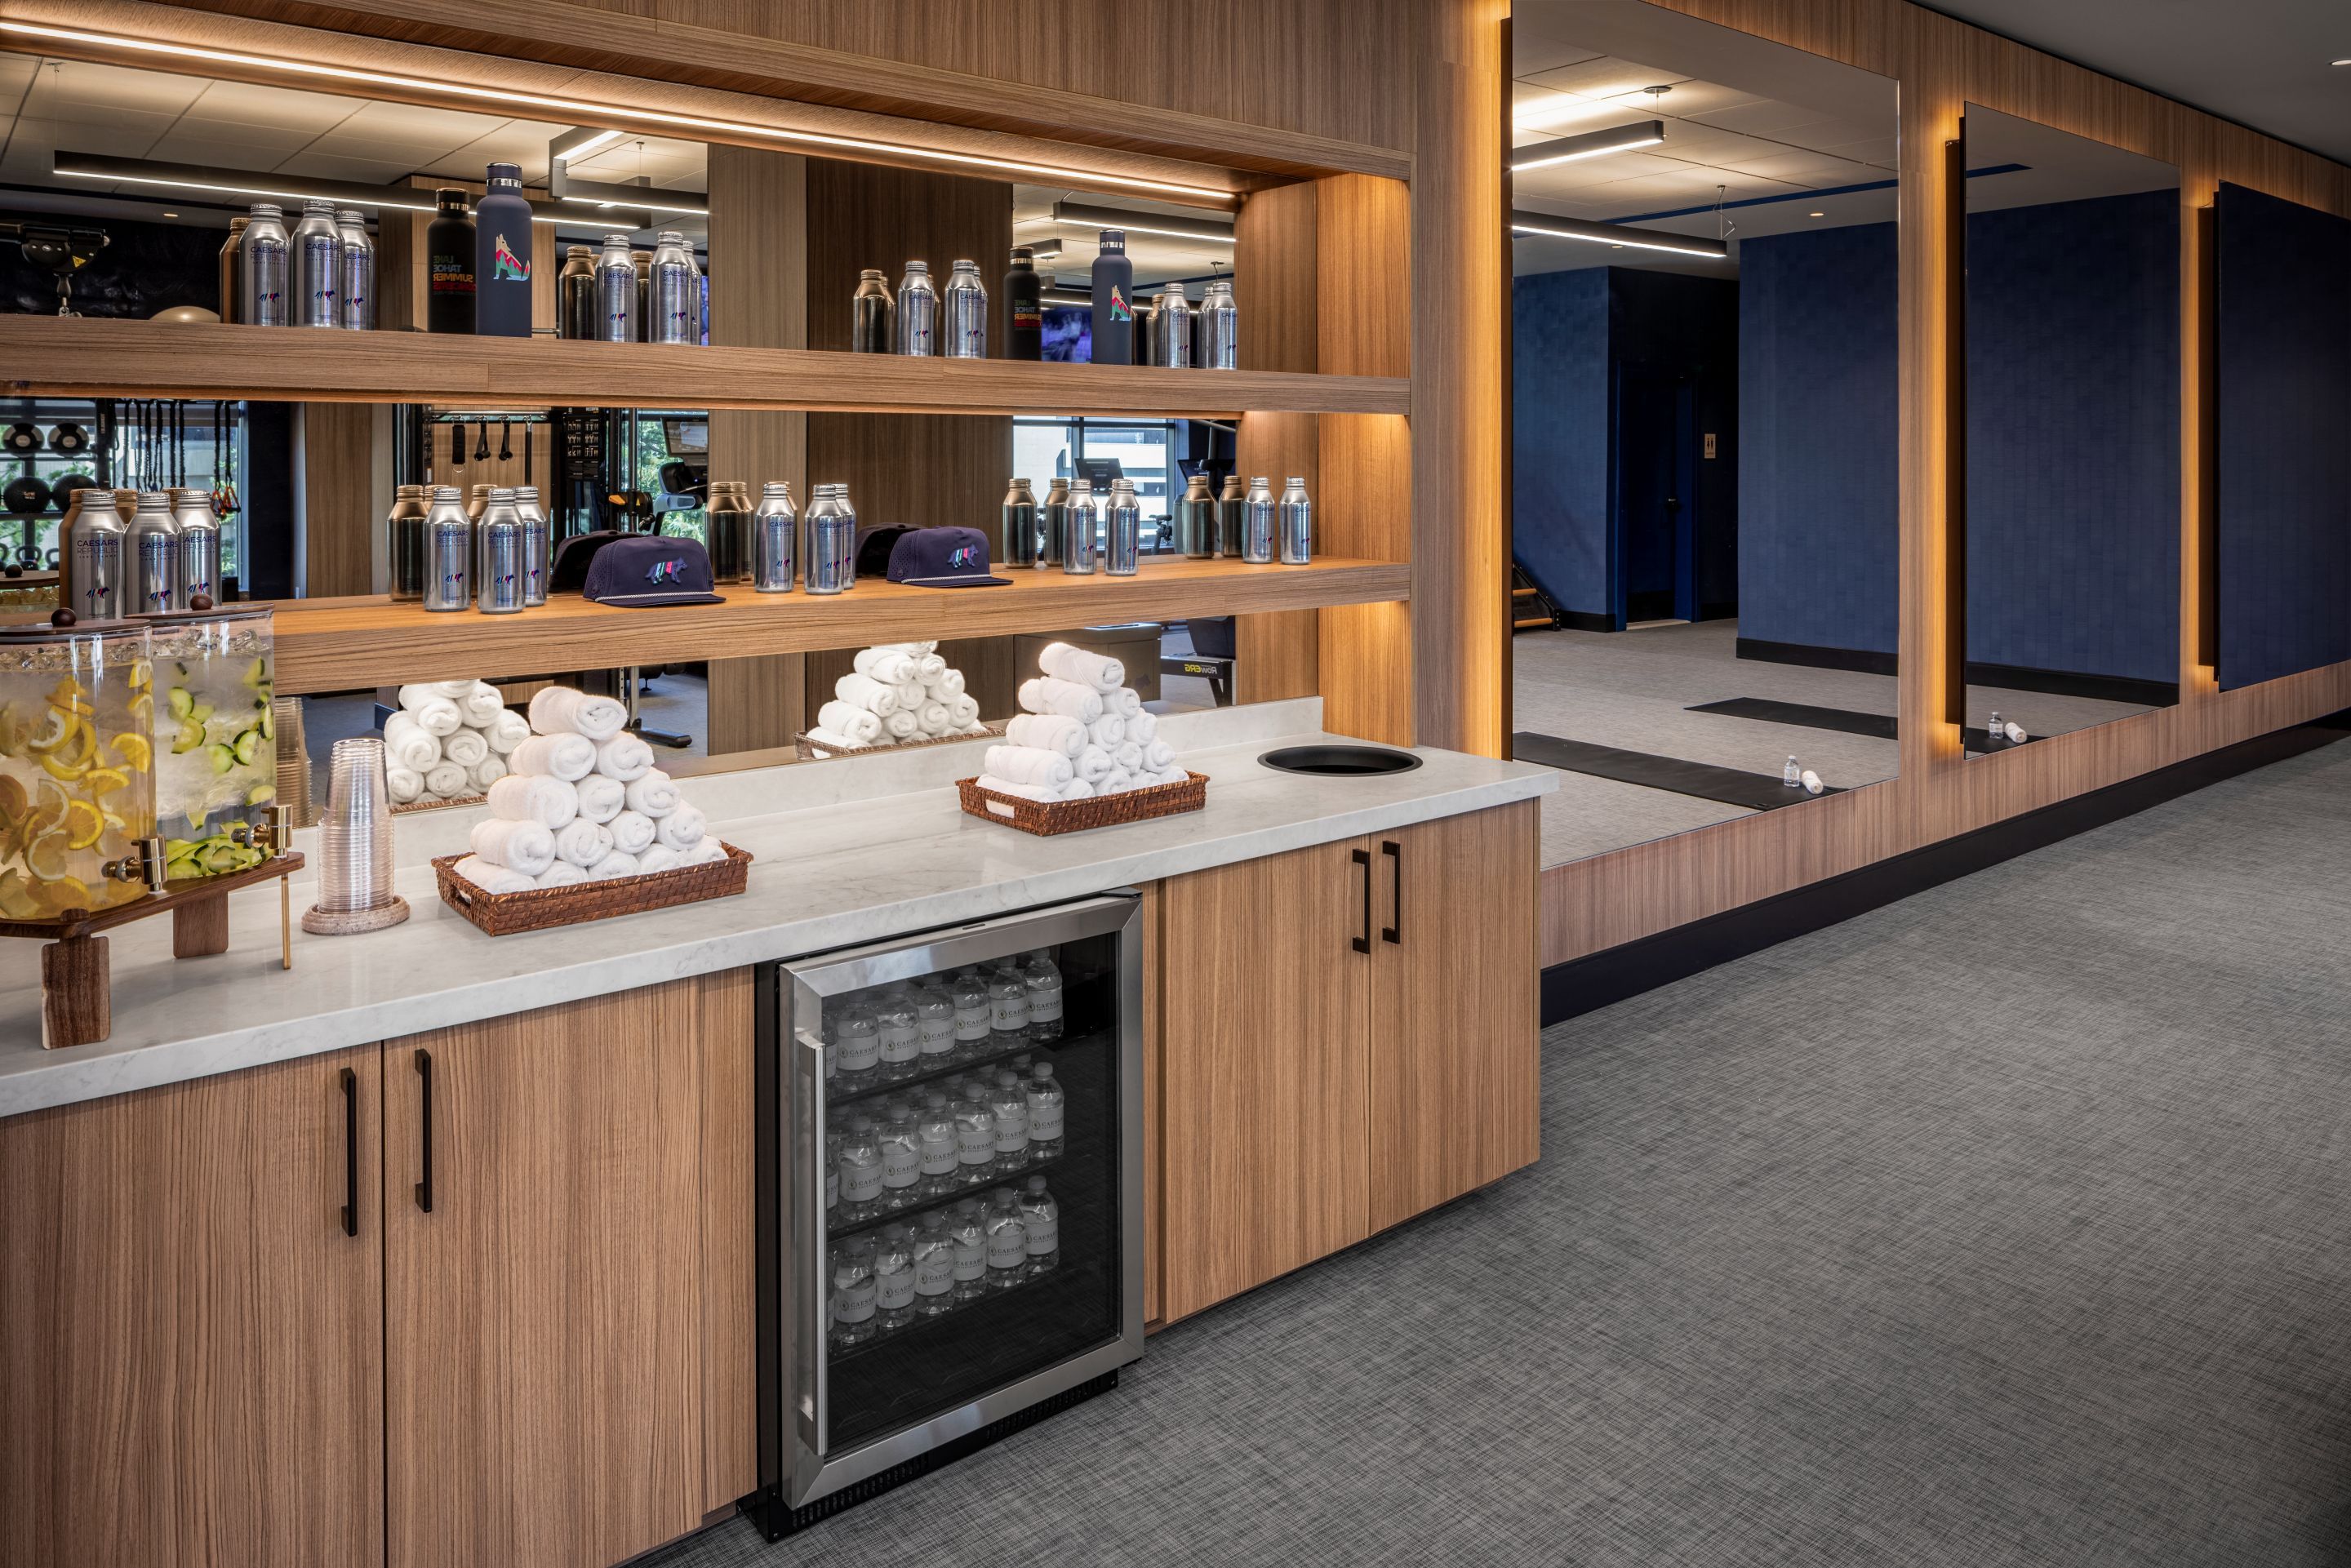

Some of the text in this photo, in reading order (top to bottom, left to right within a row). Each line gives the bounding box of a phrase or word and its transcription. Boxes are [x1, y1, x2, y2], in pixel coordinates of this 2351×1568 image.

[250, 247, 287, 255] CAESARS
[305, 243, 342, 252] CAESARS
[663, 270, 691, 278] CAESARS
[487, 531, 521, 539] CAESARS
[77, 539, 119, 547] CAESARS
[138, 541, 179, 549] CAESARS
[183, 542, 216, 550] EPUBLIC
